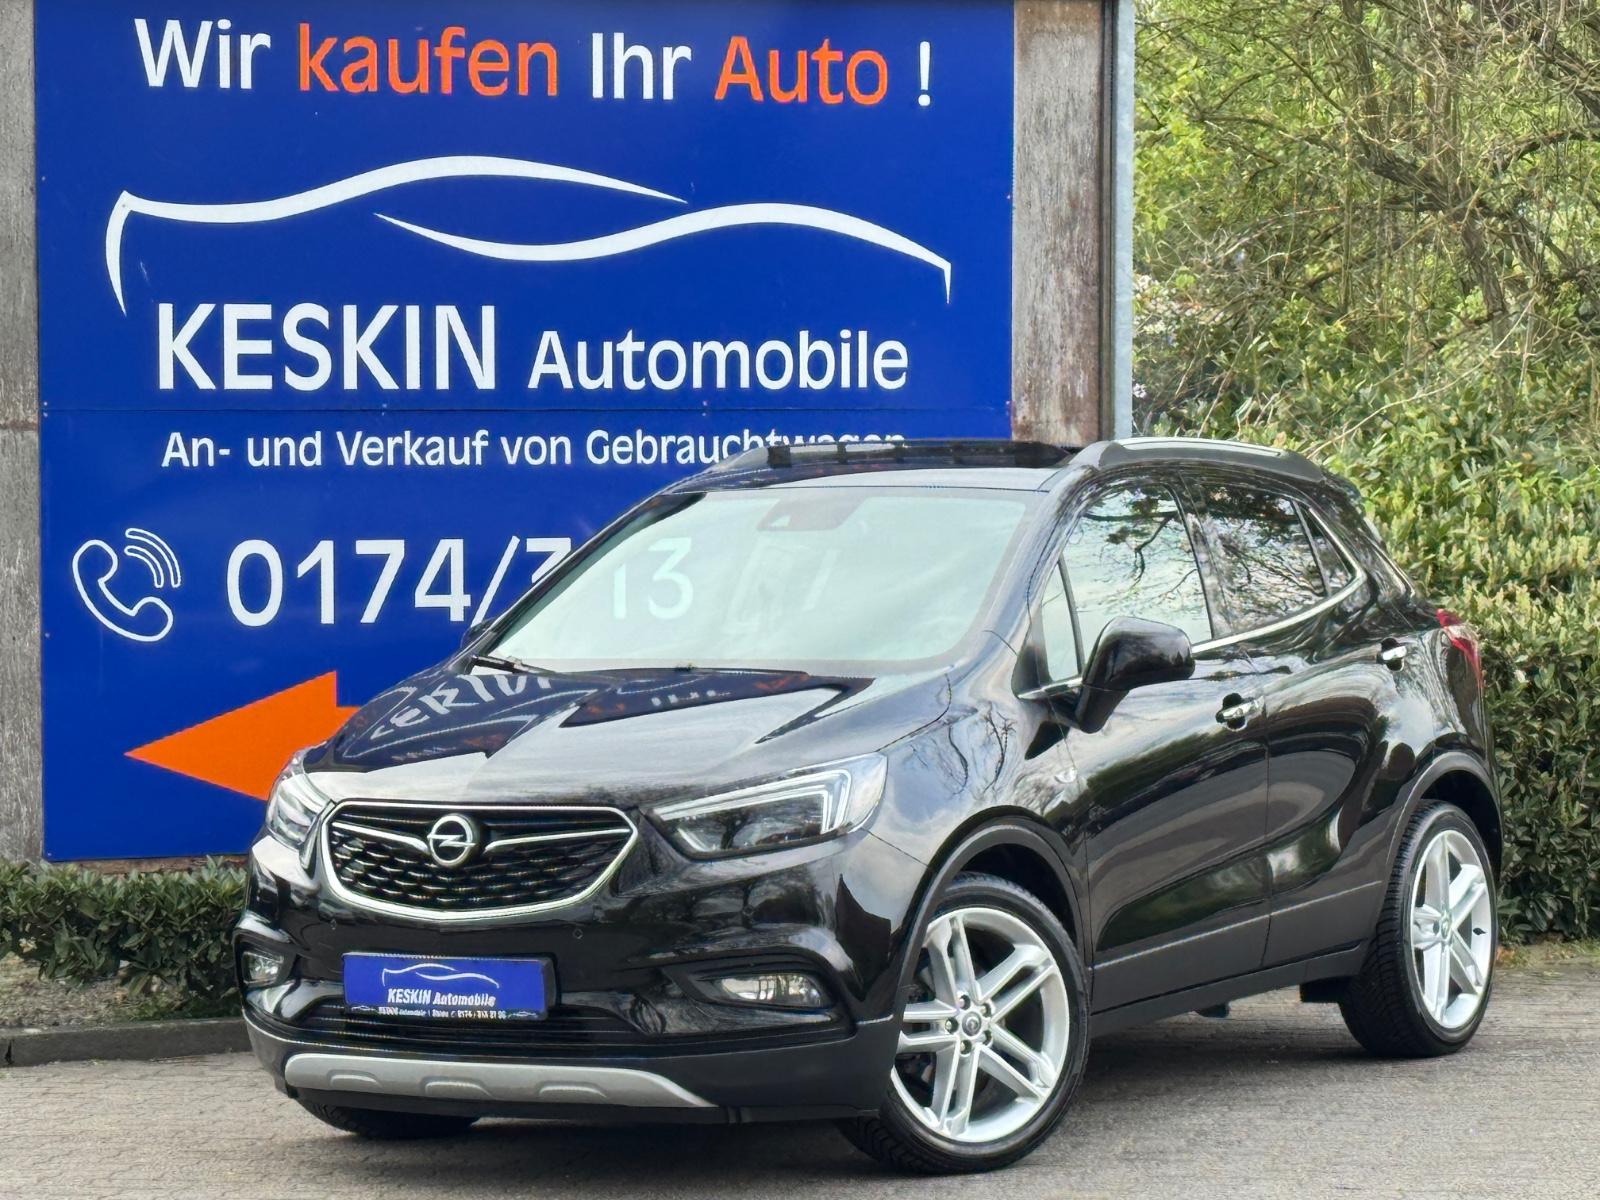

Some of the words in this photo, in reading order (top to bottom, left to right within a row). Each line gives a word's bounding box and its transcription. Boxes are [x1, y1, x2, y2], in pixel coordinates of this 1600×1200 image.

[135, 19, 271, 90] Wir
[299, 23, 558, 97] kaufen
[591, 33, 692, 101] Ihr
[715, 36, 889, 107] Auto
[917, 41, 932, 107] !
[158, 303, 496, 391] KESKIN
[528, 330, 909, 391] Automobile
[161, 431, 231, 468] An-
[247, 431, 322, 467] und
[336, 429, 489, 467] Verkauf
[500, 435, 572, 466] von
[586, 428, 906, 465] Gebraucht
[387, 988, 431, 1006] KESKIN
[433, 991, 497, 1007] Automobile
